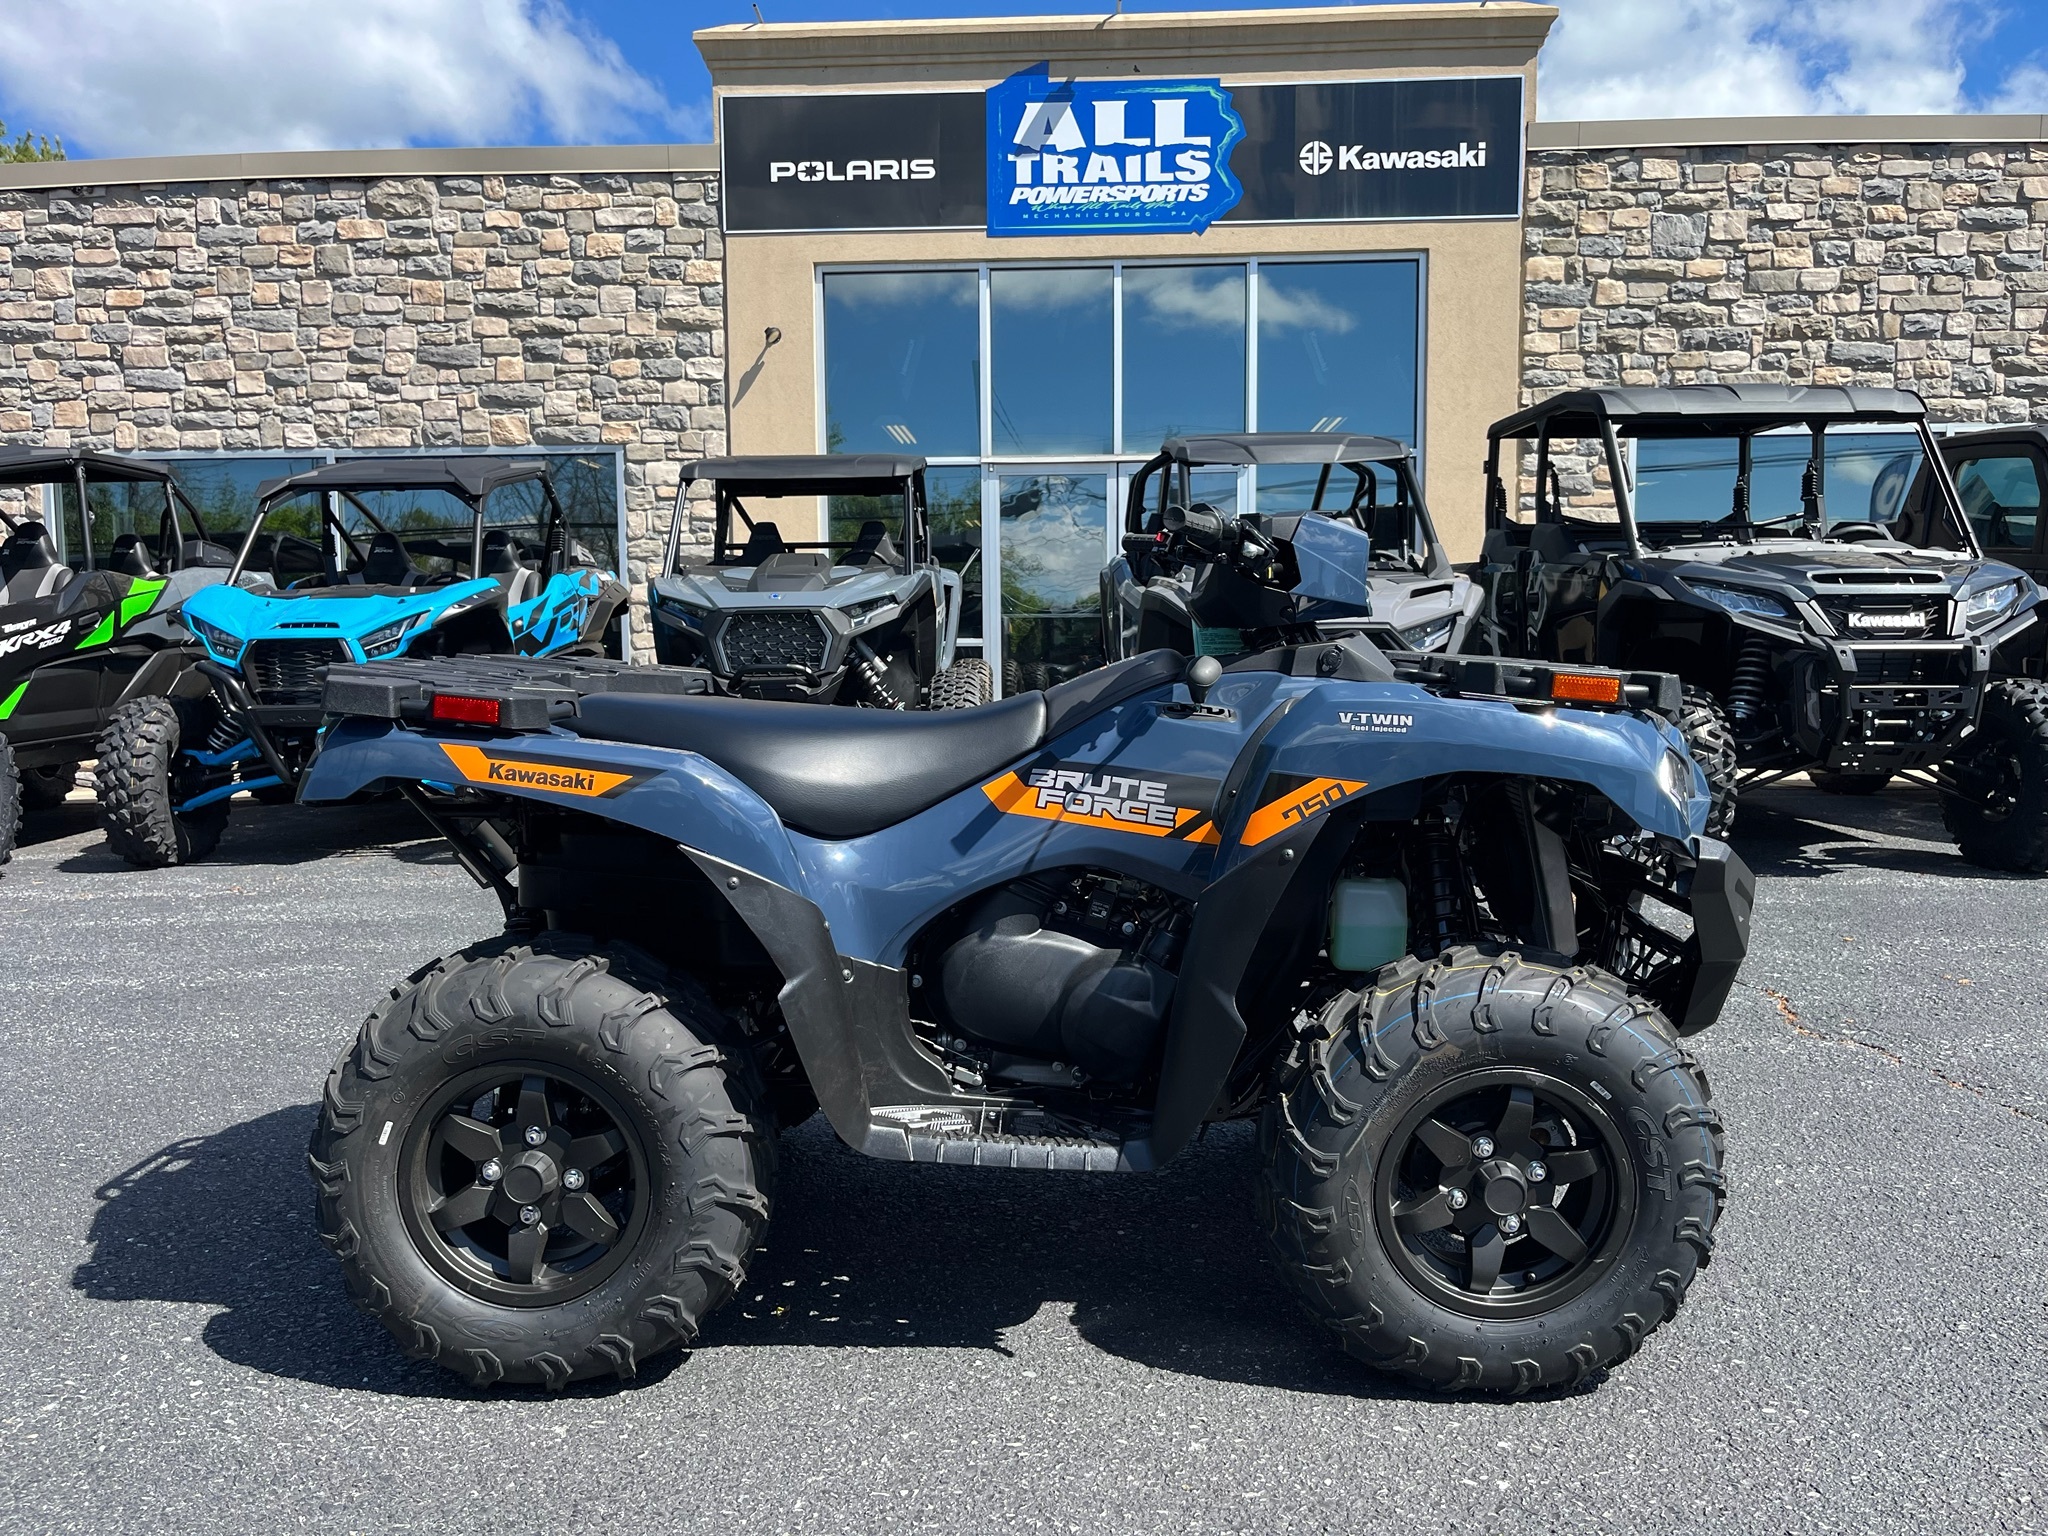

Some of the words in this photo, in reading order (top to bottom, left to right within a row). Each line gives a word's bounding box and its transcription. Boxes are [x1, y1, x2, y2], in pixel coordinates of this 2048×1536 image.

[1013, 99, 1211, 152] ALL
[1008, 150, 1211, 184] TRAILS
[1338, 141, 1487, 170] Kawasaki
[770, 159, 936, 183] POLARIS
[1009, 184, 1210, 205] POWERSPORTS
[1848, 612, 1926, 628] Kawasaki
[38, 635, 65, 650] 1000
[1338, 712, 1413, 726] V-TWIN
[1371, 725, 1407, 733] Injected
[488, 762, 595, 791] Kawasaki
[1028, 768, 1168, 804] BRUTE
[1037, 788, 1177, 827] FORCE
[1281, 782, 1348, 824] 750
[442, 1027, 547, 1064] CST
[1625, 1105, 1673, 1202] CST
